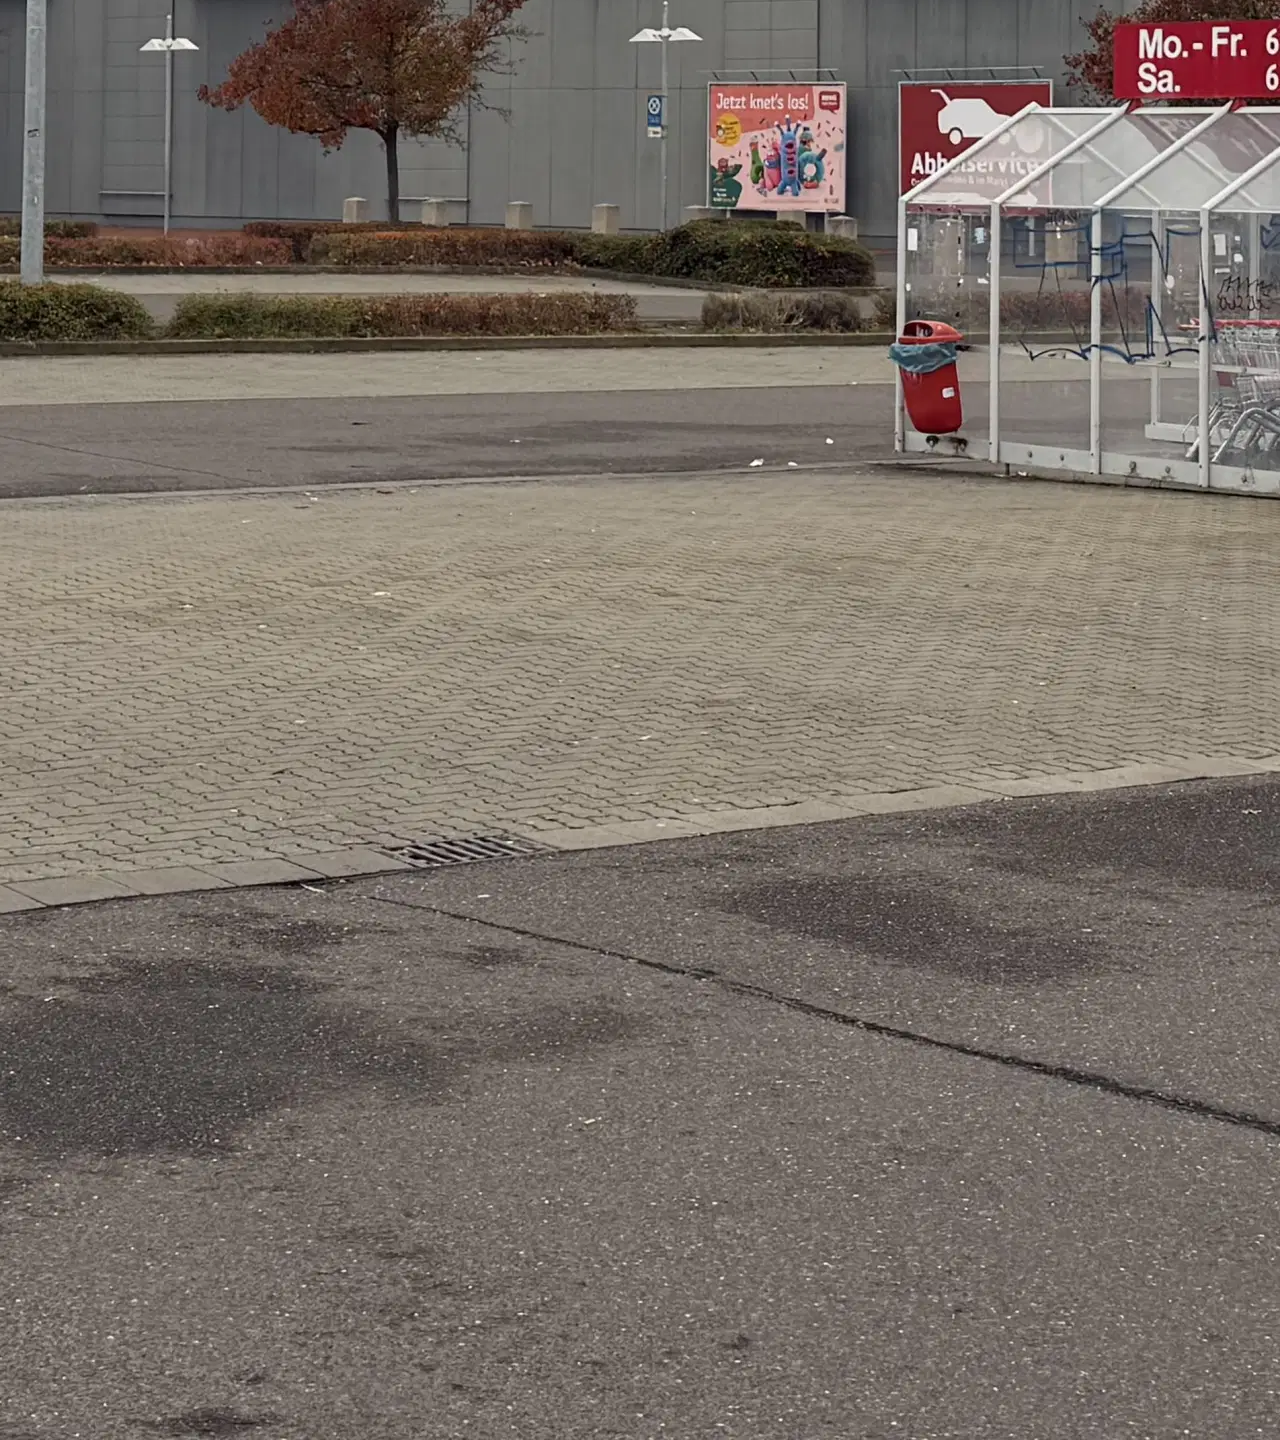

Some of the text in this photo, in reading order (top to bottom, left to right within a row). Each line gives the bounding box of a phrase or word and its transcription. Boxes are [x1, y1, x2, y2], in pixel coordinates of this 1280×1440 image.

[1211, 26, 1247, 57] Fr.
[1265, 28, 1279, 55] 6
[1137, 63, 1180, 93] Sa.
[1265, 64, 1279, 91] 6
[716, 93, 809, 109] Jetzt knet's los!
